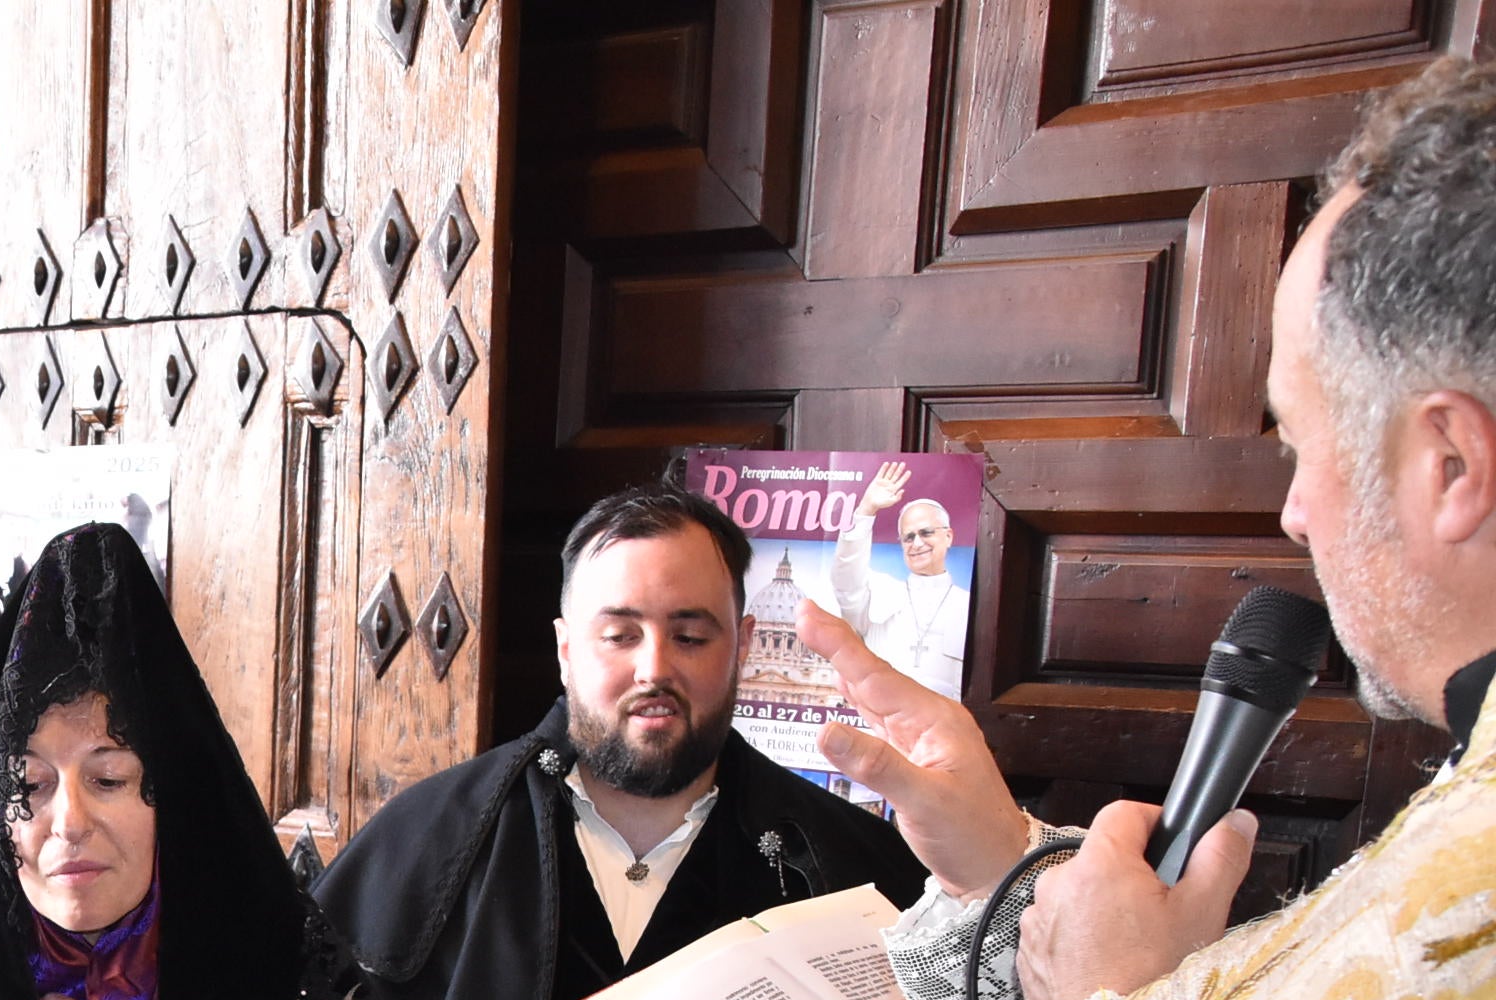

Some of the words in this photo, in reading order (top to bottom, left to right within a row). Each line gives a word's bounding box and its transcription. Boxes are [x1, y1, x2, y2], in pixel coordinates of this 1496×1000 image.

[105, 456, 161, 473] 2025
[740, 465, 806, 482] Peregrinación
[704, 465, 857, 533] Roma
[733, 704, 754, 717] 20
[757, 705, 771, 718] al
[776, 708, 798, 722] 27
[802, 708, 822, 723] de
[749, 724, 768, 733] con
